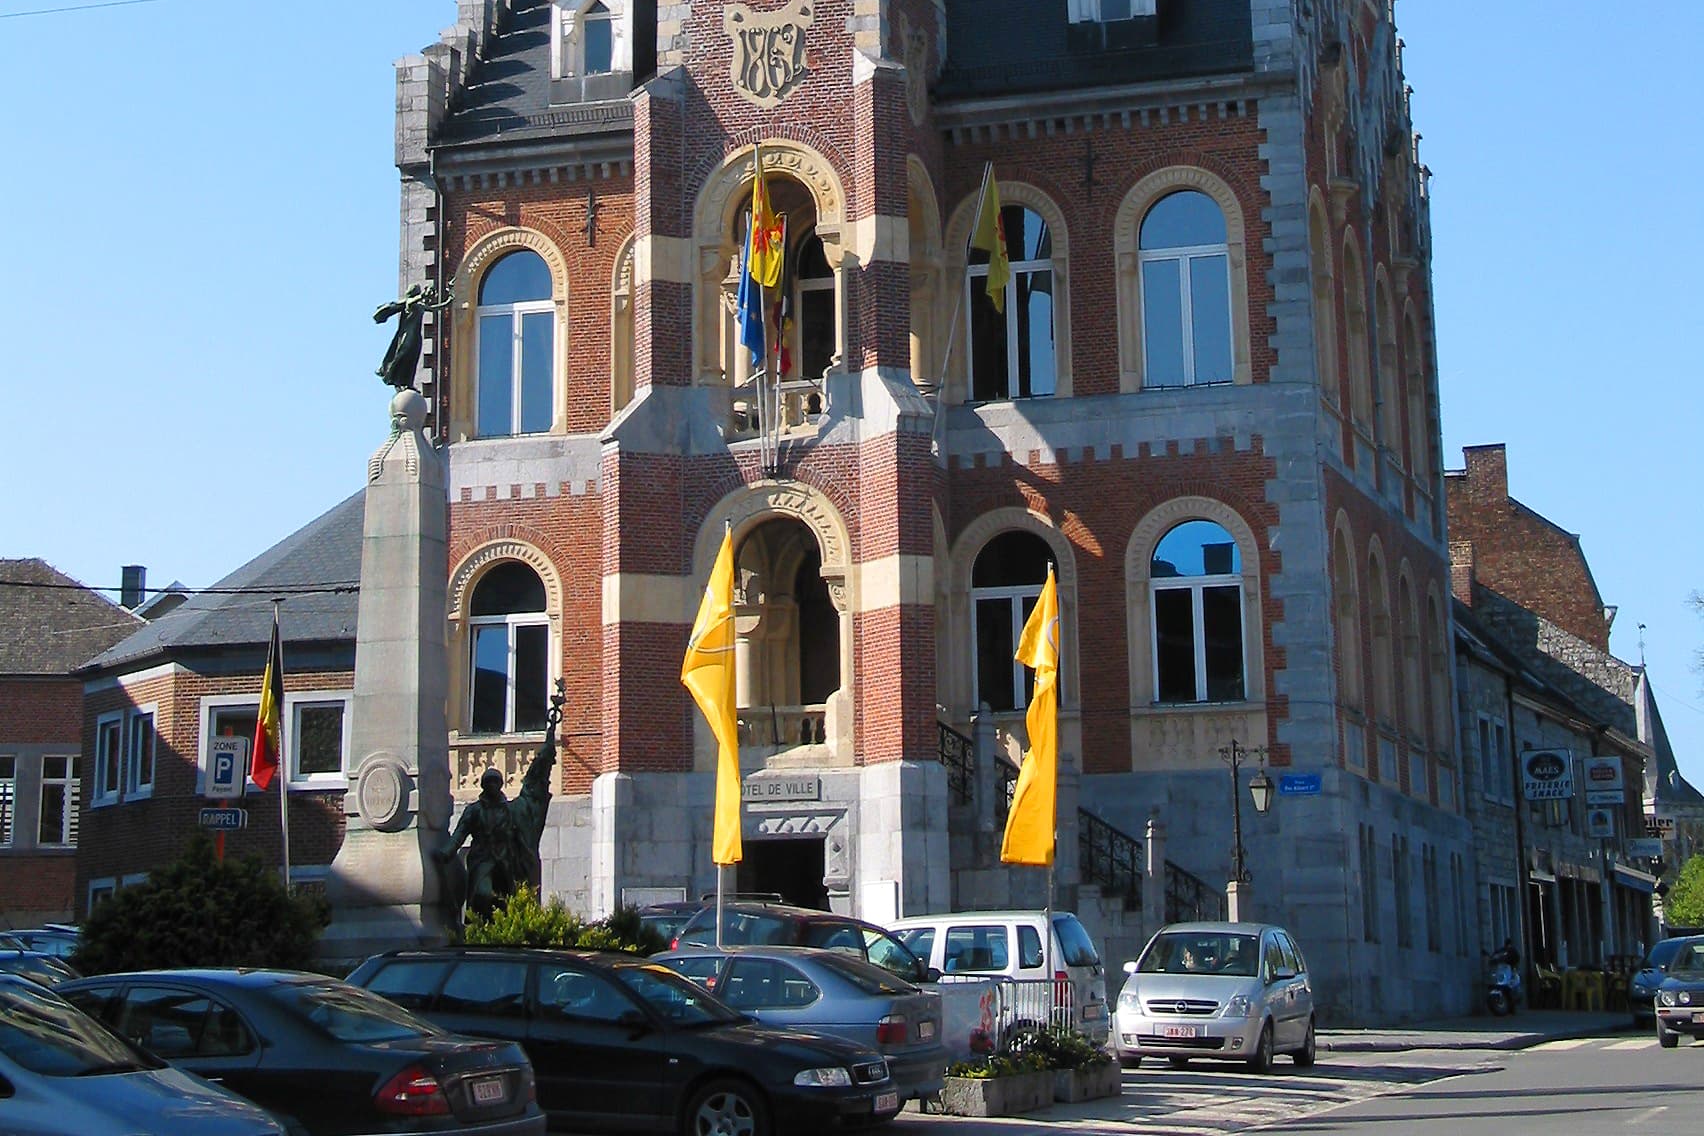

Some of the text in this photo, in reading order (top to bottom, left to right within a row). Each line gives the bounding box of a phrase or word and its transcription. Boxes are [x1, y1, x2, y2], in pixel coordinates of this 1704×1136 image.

[213, 742, 238, 751] ZONE
[217, 758, 231, 779] P
[1534, 766, 1559, 774] MAES
[742, 782, 813, 796] OTEL DE VILLE
[1525, 780, 1570, 790] FRITERIE
[1533, 789, 1564, 798] SNACK
[203, 814, 236, 825] RAPPEL
